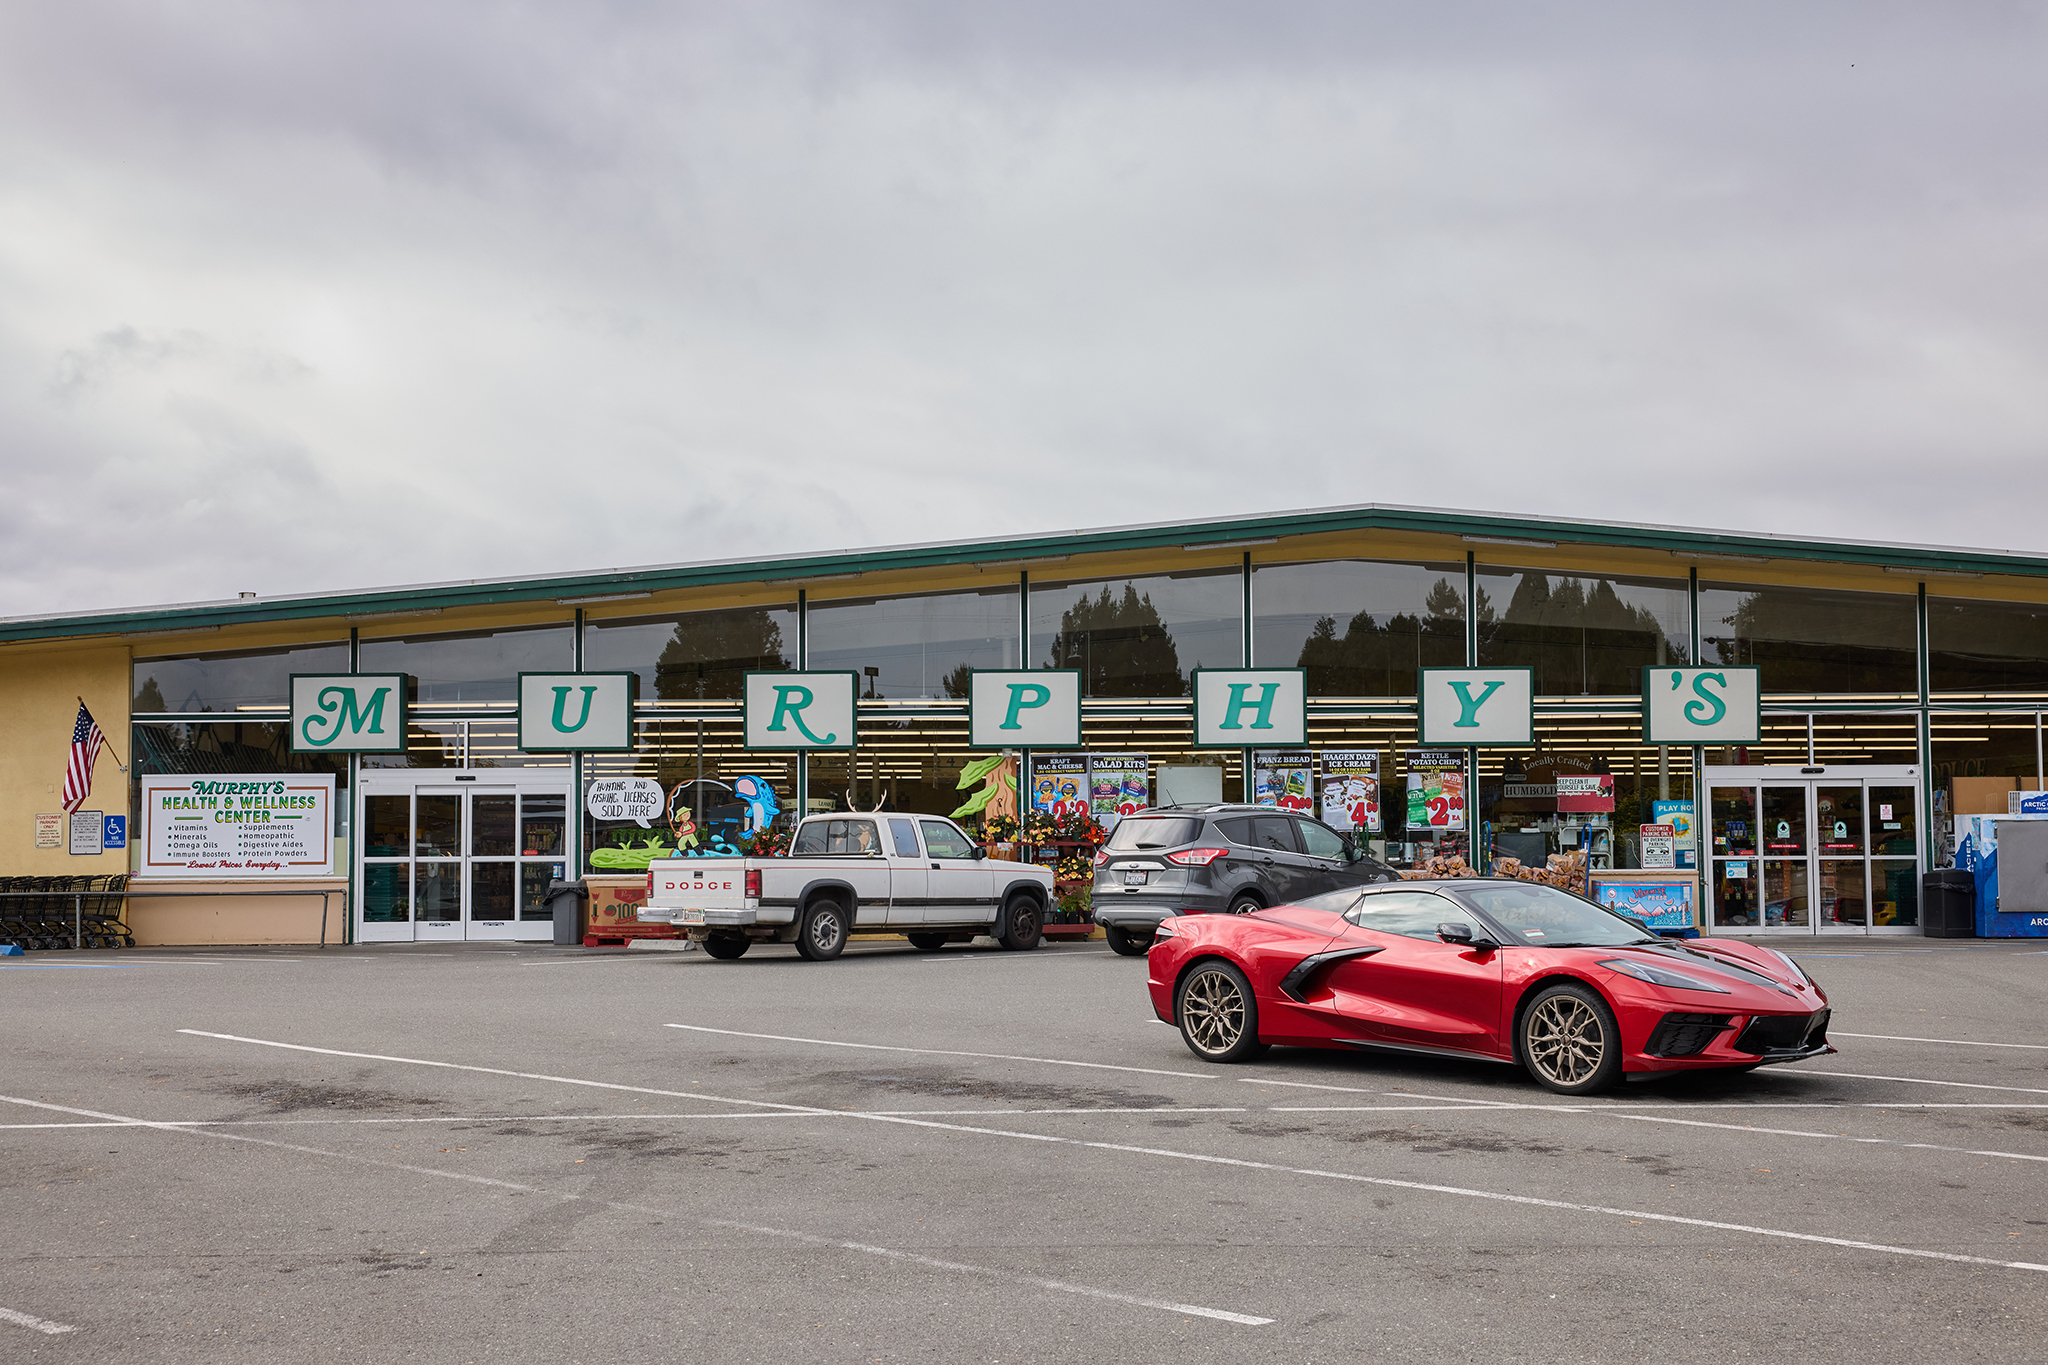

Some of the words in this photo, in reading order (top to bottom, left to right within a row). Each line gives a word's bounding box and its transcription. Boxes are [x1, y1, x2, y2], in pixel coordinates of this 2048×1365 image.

[1093, 760, 1122, 768] SALAD
[1123, 760, 1145, 768] KITS
[1257, 756, 1283, 764] FRANZ
[1522, 756, 1555, 771] Locally
[1556, 755, 1591, 771] Crafted
[192, 781, 284, 795] MURPHY'S
[596, 781, 626, 792] HUNTING
[634, 781, 648, 789] AND
[162, 796, 218, 810] HEALTH
[224, 796, 234, 809] &
[240, 795, 316, 809] WELLNESS
[591, 792, 619, 804] FISHING
[624, 791, 657, 804] LICENSES
[215, 810, 271, 823] CENTER
[601, 805, 623, 817] SOLD
[628, 805, 651, 817] HERE
[244, 832, 294, 840] Homeopathic
[173, 842, 200, 850] Omega
[243, 841, 279, 849] Digestive
[187, 860, 216, 869] Lowest
[219, 860, 242, 868] Prices
[666, 882, 732, 890] DODGE
[1632, 887, 1666, 898] YOSEMITE
